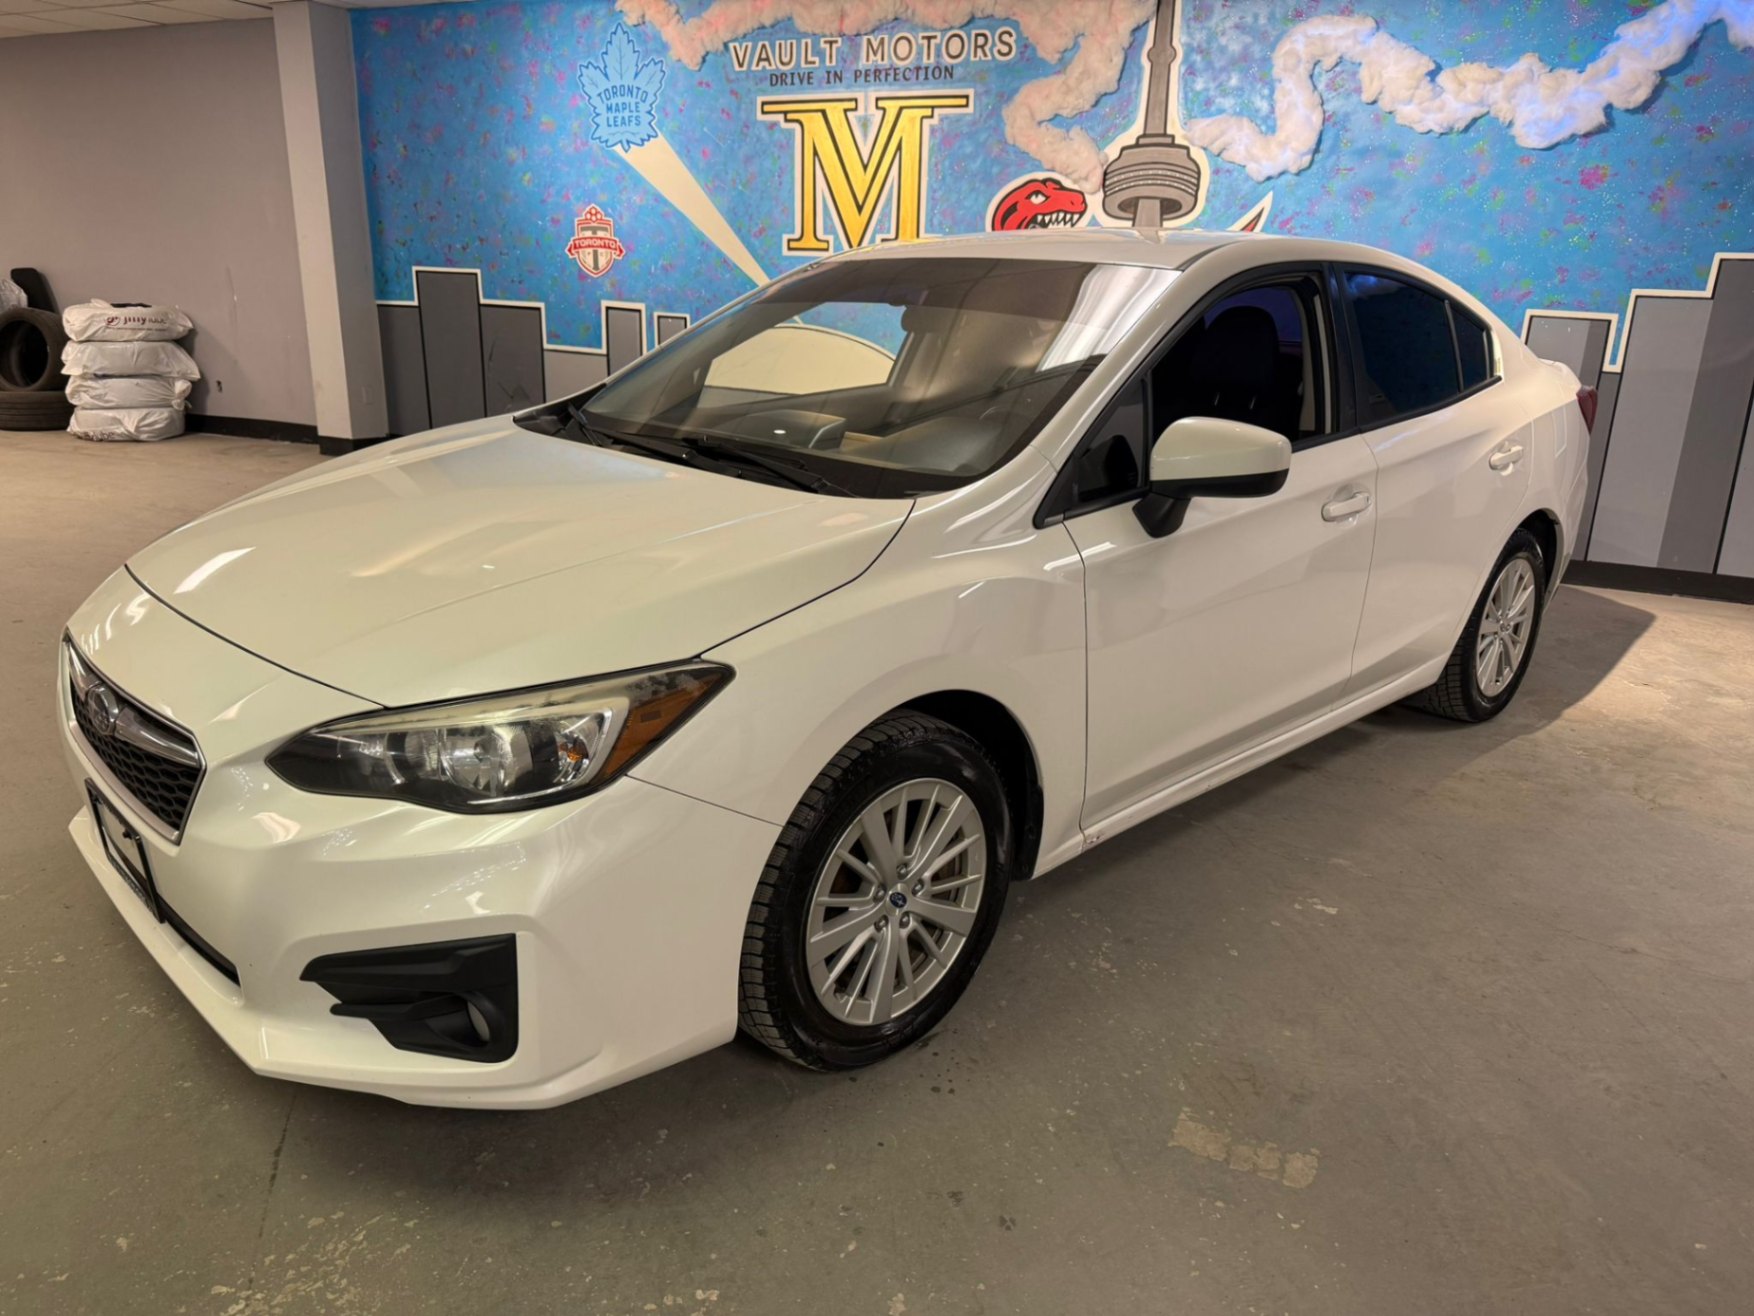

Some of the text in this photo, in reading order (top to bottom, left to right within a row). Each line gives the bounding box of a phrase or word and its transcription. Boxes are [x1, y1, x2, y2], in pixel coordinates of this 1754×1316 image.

[731, 29, 1015, 70] VAULT MOTORS
[769, 65, 954, 87] DRIVE IN PERFECTION
[597, 84, 649, 104] TORONTO
[606, 101, 641, 115] MAPLE
[606, 115, 642, 128] LEAFS
[574, 239, 616, 248] TORONTO
